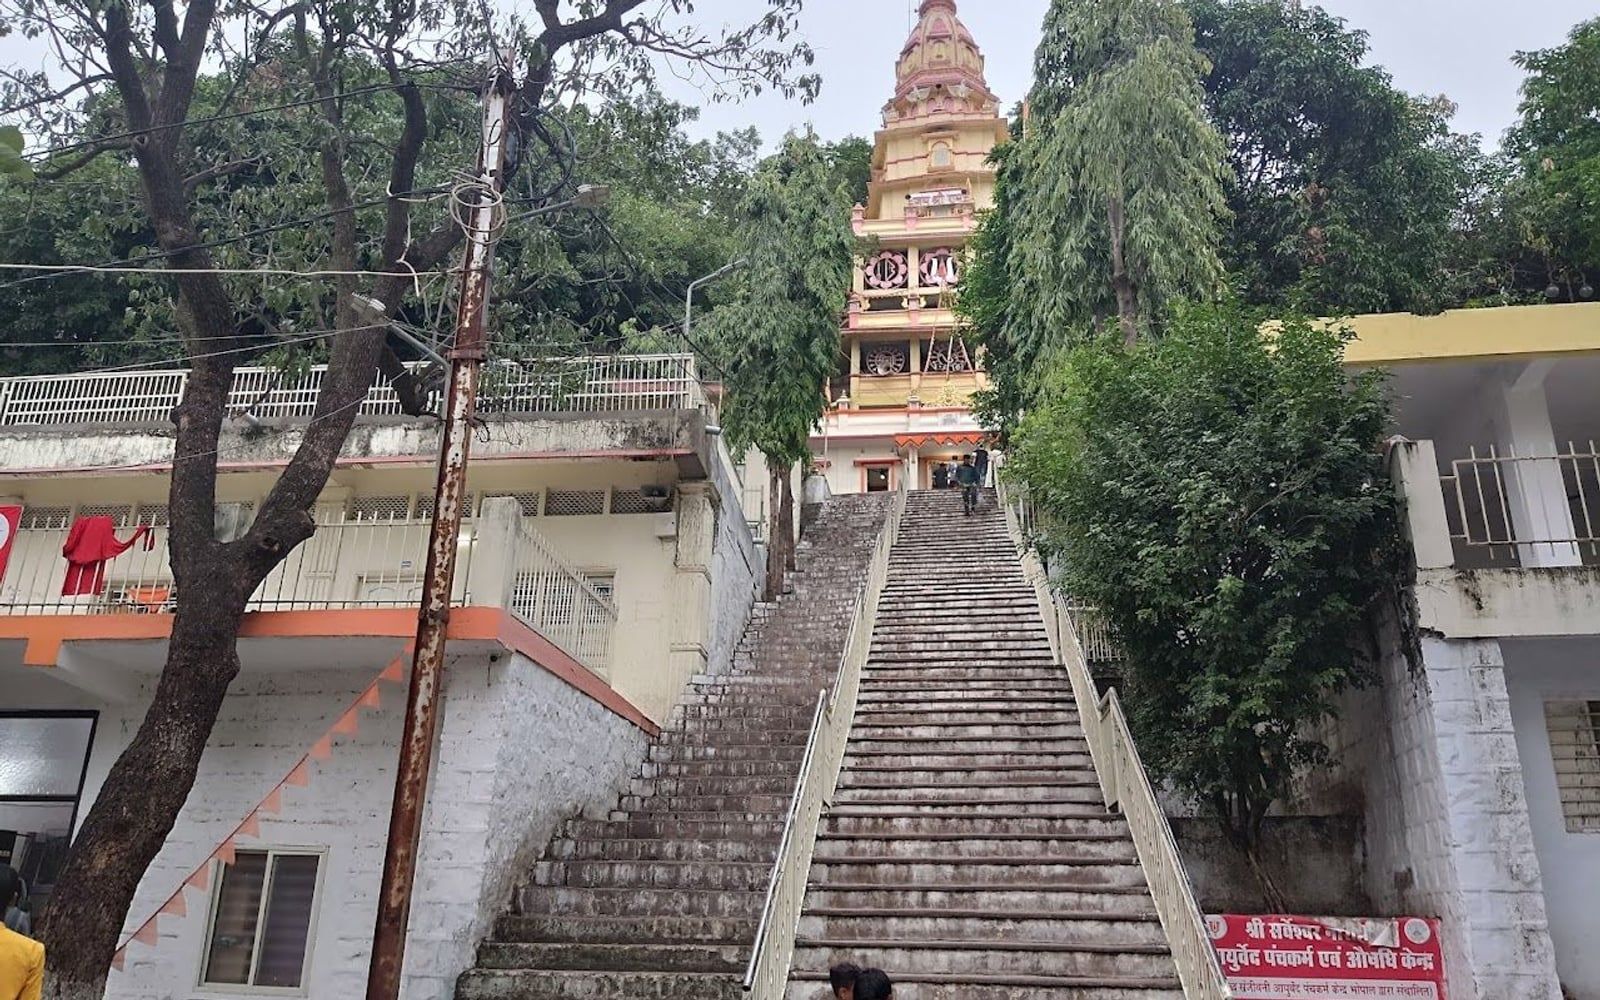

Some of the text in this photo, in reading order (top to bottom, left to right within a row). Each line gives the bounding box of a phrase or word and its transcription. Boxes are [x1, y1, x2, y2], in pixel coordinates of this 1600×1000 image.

[1245, 917, 1265, 939] श्री
[1268, 918, 1322, 940] सर्वेश्वर
[1263, 944, 1315, 968] पंचकर्म
[1317, 945, 1342, 969] एवं
[1345, 945, 1398, 970] औषधि
[1400, 947, 1435, 971] केन्द्र
